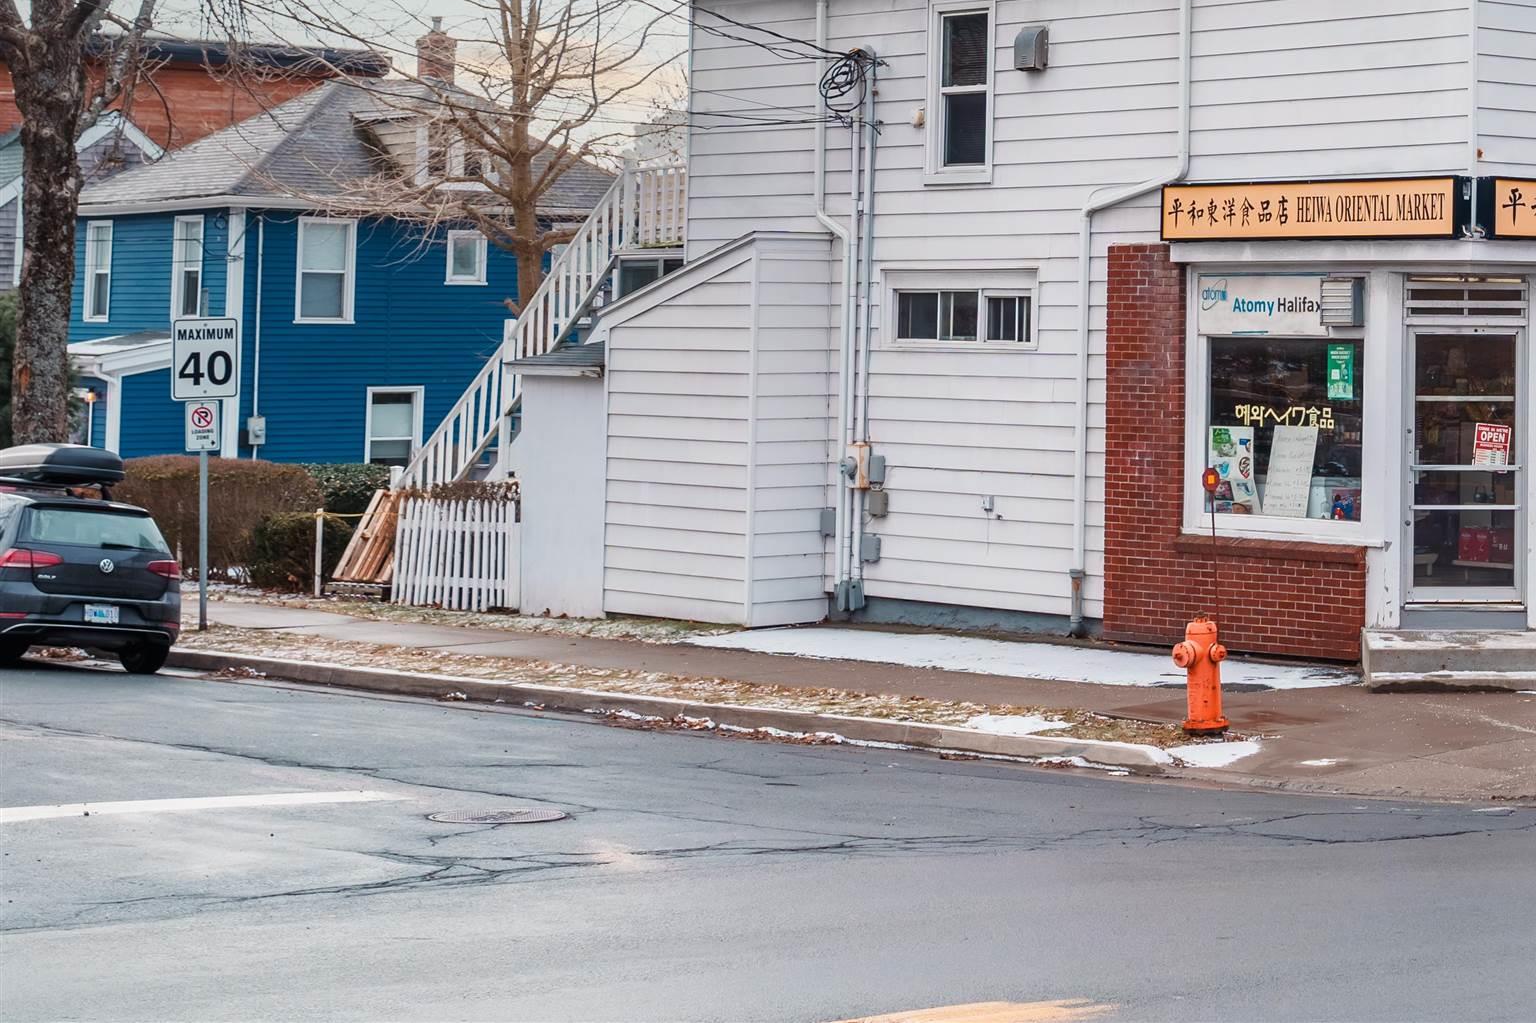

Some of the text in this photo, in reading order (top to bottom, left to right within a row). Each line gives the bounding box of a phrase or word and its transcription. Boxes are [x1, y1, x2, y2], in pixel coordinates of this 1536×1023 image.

[1168, 192, 1447, 227] 平和東洋食品店 HEIWA ORIENTAL MARKET
[1232, 296, 1321, 316] Atomy Halifax
[177, 328, 234, 341] MAXIMUM
[178, 350, 233, 386] 40
[1480, 430, 1506, 443] OPEN
